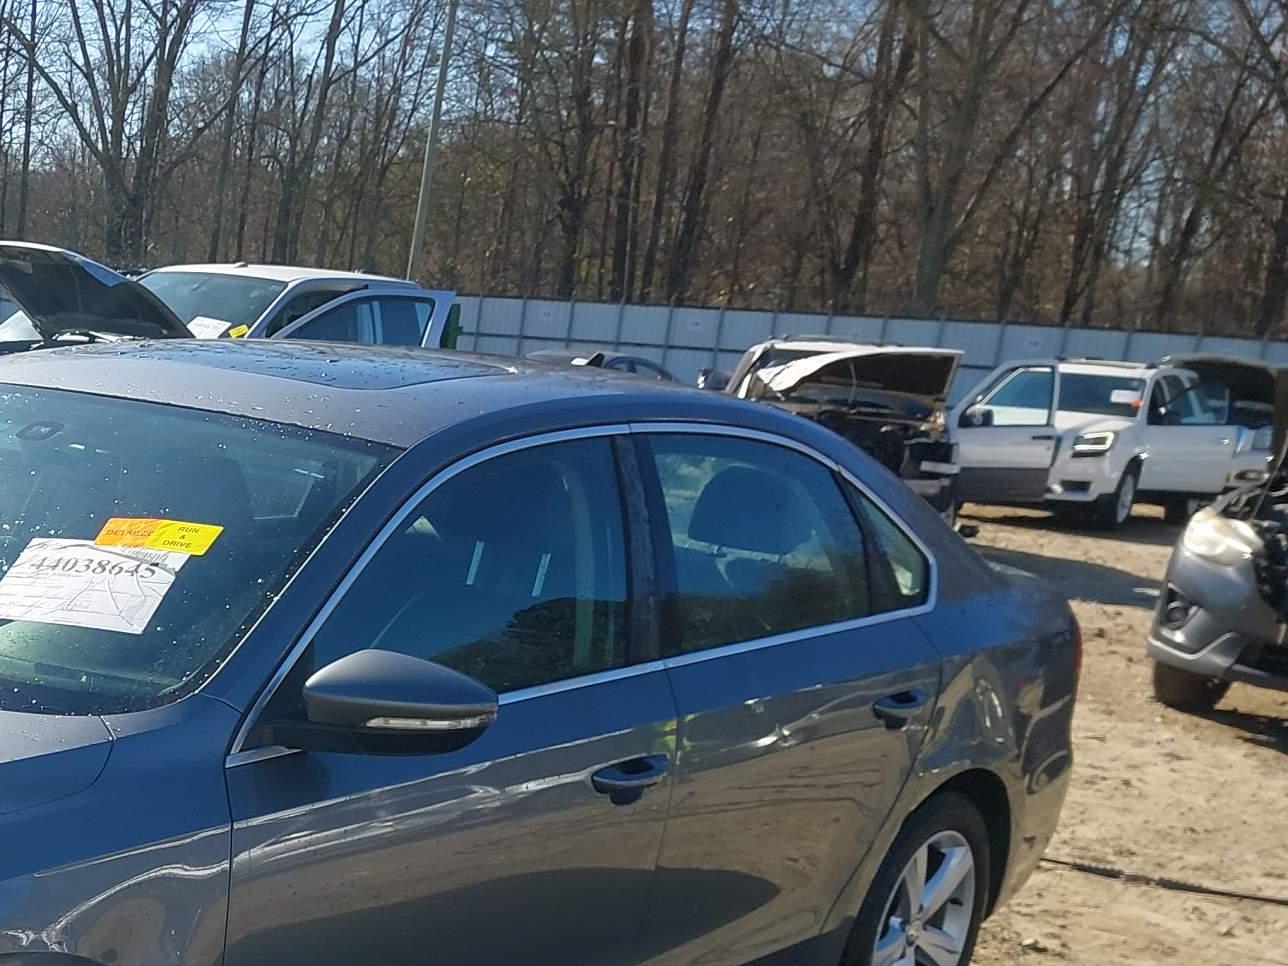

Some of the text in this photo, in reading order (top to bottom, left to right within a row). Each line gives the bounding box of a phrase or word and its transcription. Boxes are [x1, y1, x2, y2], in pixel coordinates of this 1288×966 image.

[177, 526, 200, 534] RUN
[162, 539, 193, 549] DRIVE
[30, 556, 158, 579] 44038645
